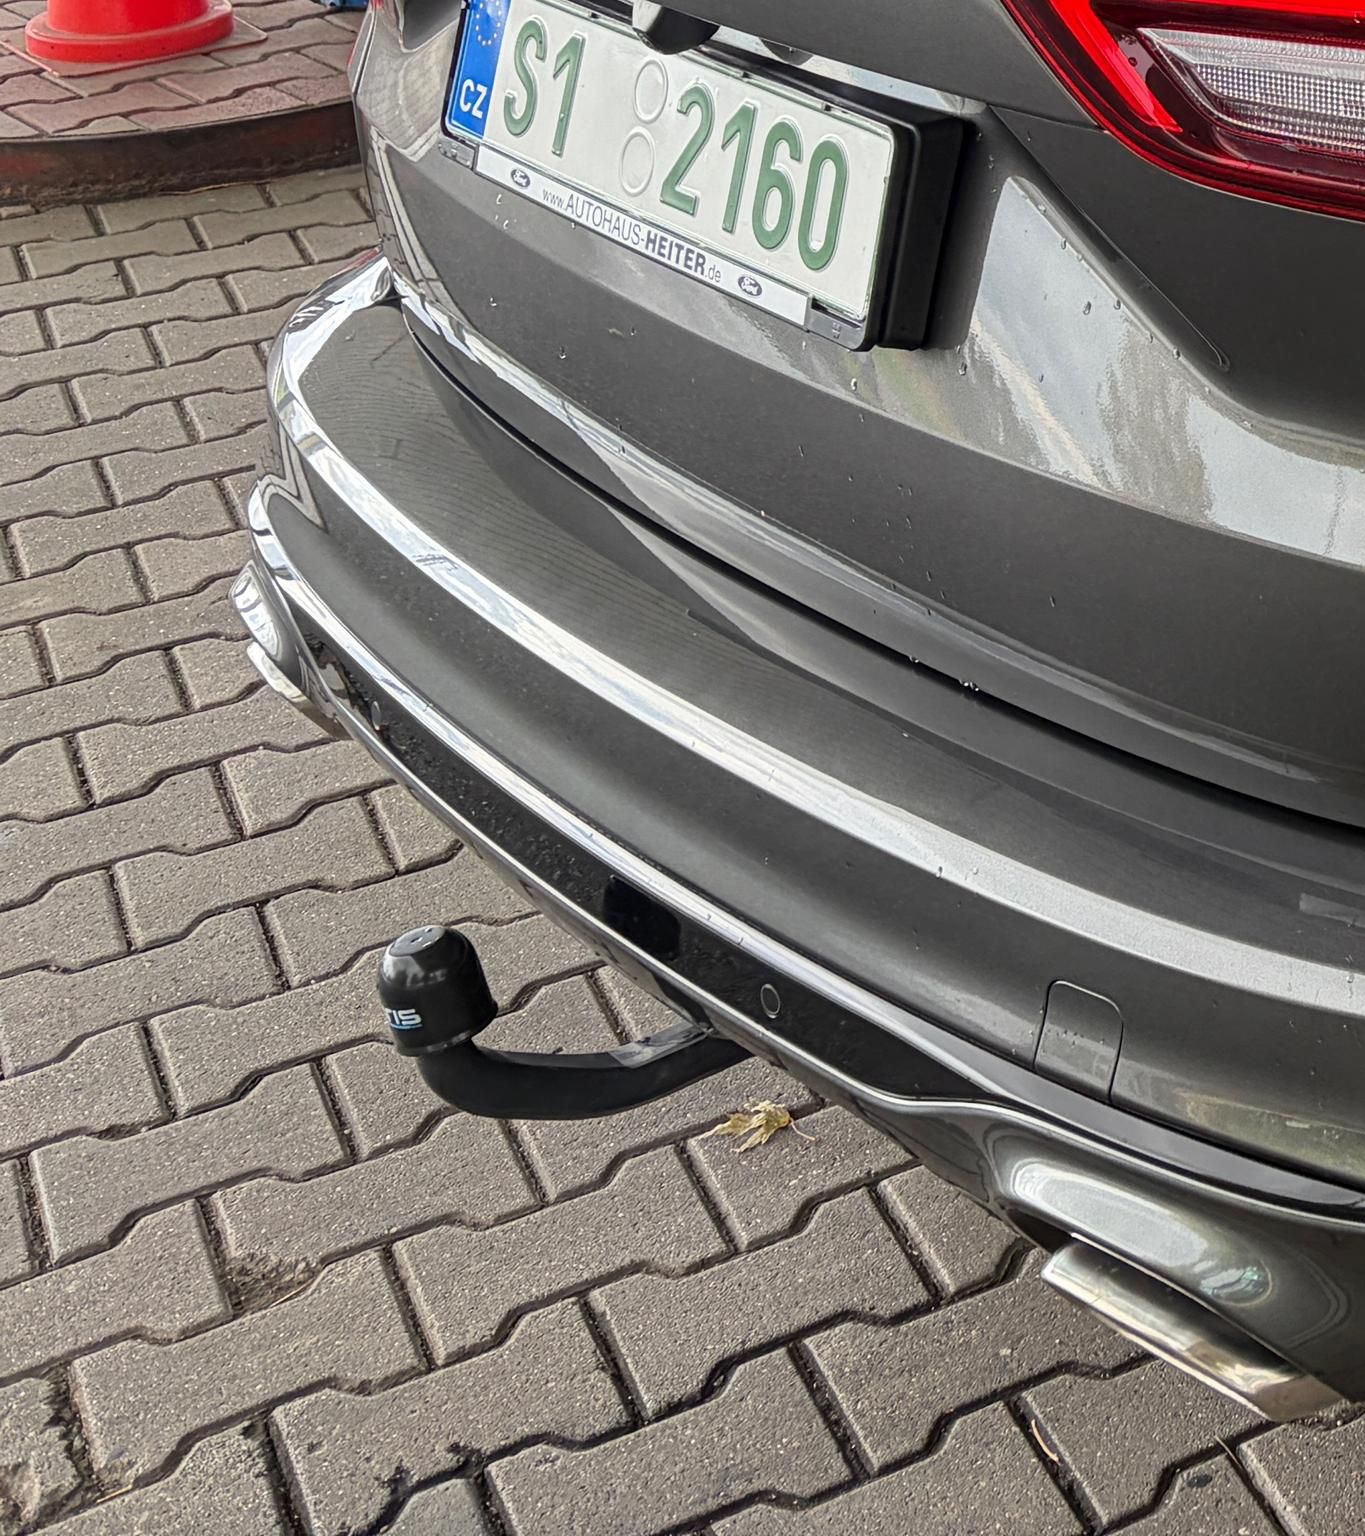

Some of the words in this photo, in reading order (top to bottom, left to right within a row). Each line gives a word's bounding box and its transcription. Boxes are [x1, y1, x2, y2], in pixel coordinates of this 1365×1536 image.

[458, 78, 489, 119] CZ
[503, 15, 588, 157] S1
[659, 80, 850, 272] 2160
[542, 188, 722, 283] www.AUTOHAUS-HEITER.de
